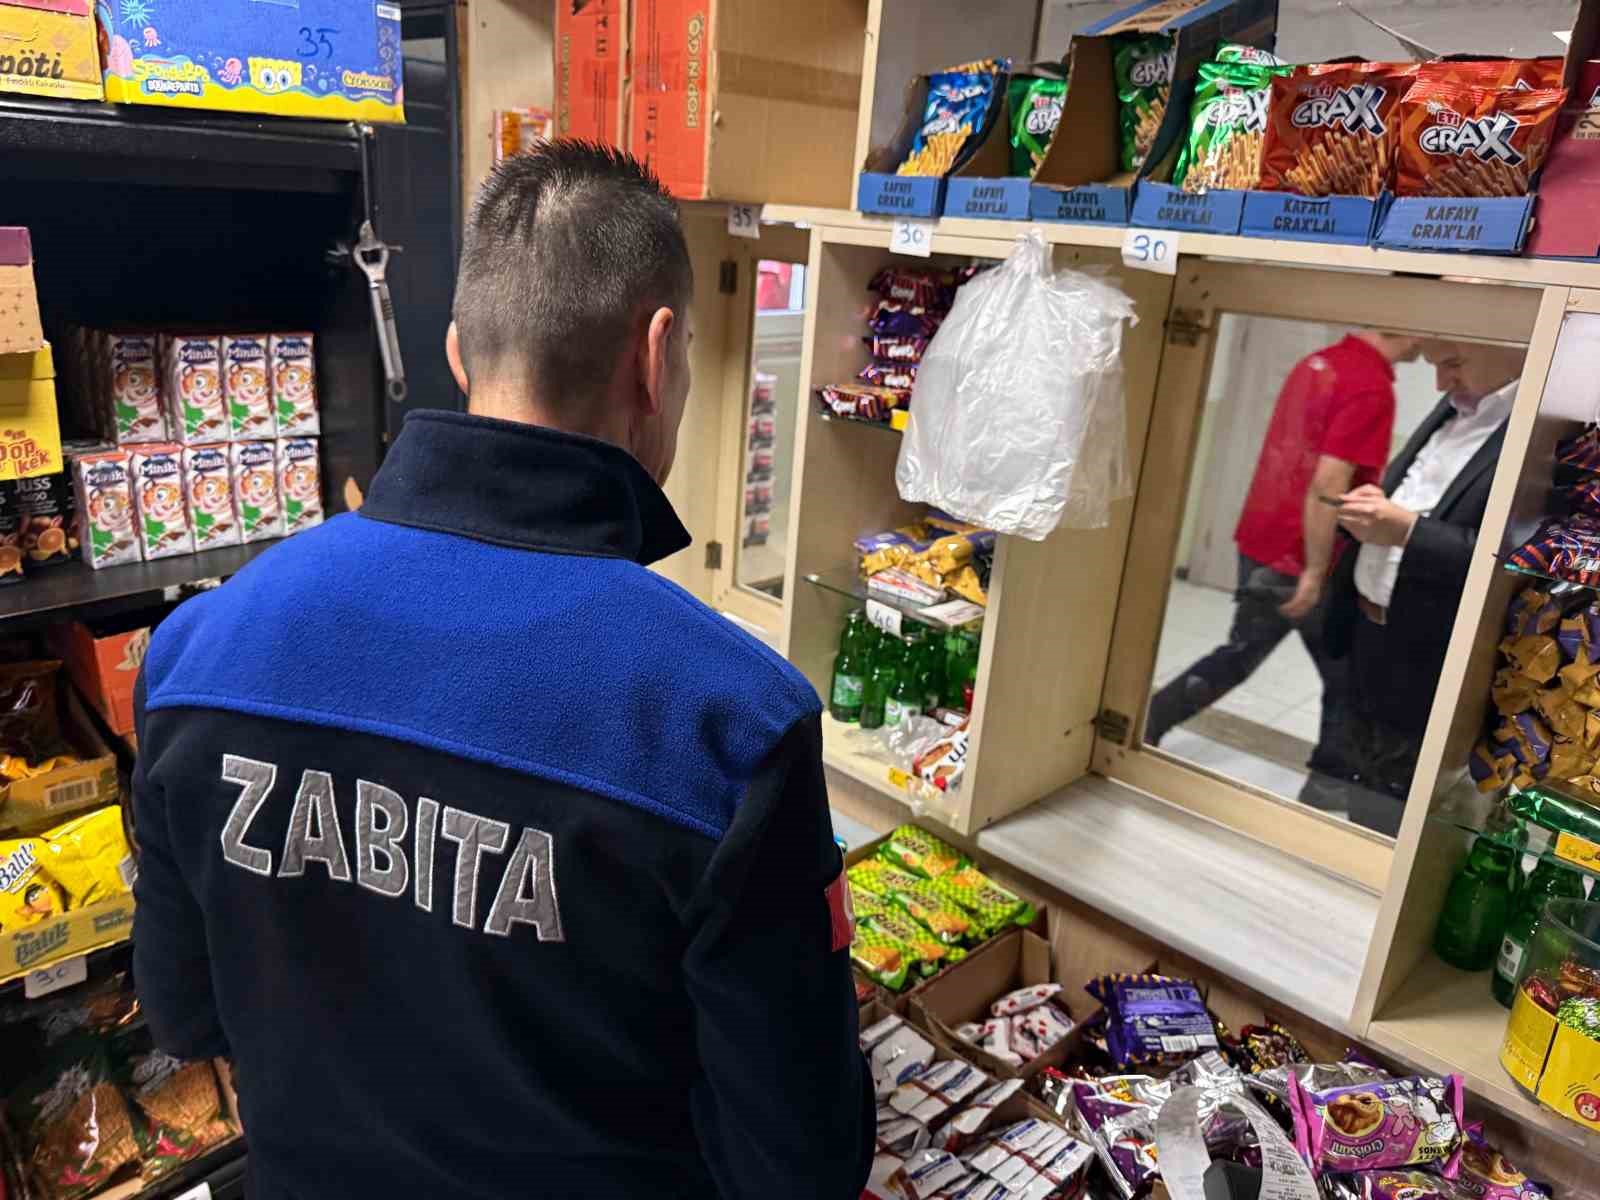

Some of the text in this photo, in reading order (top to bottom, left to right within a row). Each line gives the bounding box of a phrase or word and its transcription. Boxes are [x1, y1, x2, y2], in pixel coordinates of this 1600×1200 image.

[296, 26, 340, 59] 35
[1207, 89, 1271, 134] CRAX
[1291, 83, 1388, 138] CRAX
[1420, 109, 1525, 168] CRAX
[1425, 206, 1480, 221] KAFAYI
[899, 223, 924, 245] 30
[1411, 223, 1483, 241] CRAX'LA!
[1133, 234, 1167, 262] 30
[18, 449, 49, 474] kek
[221, 753, 565, 942] ZABITA
